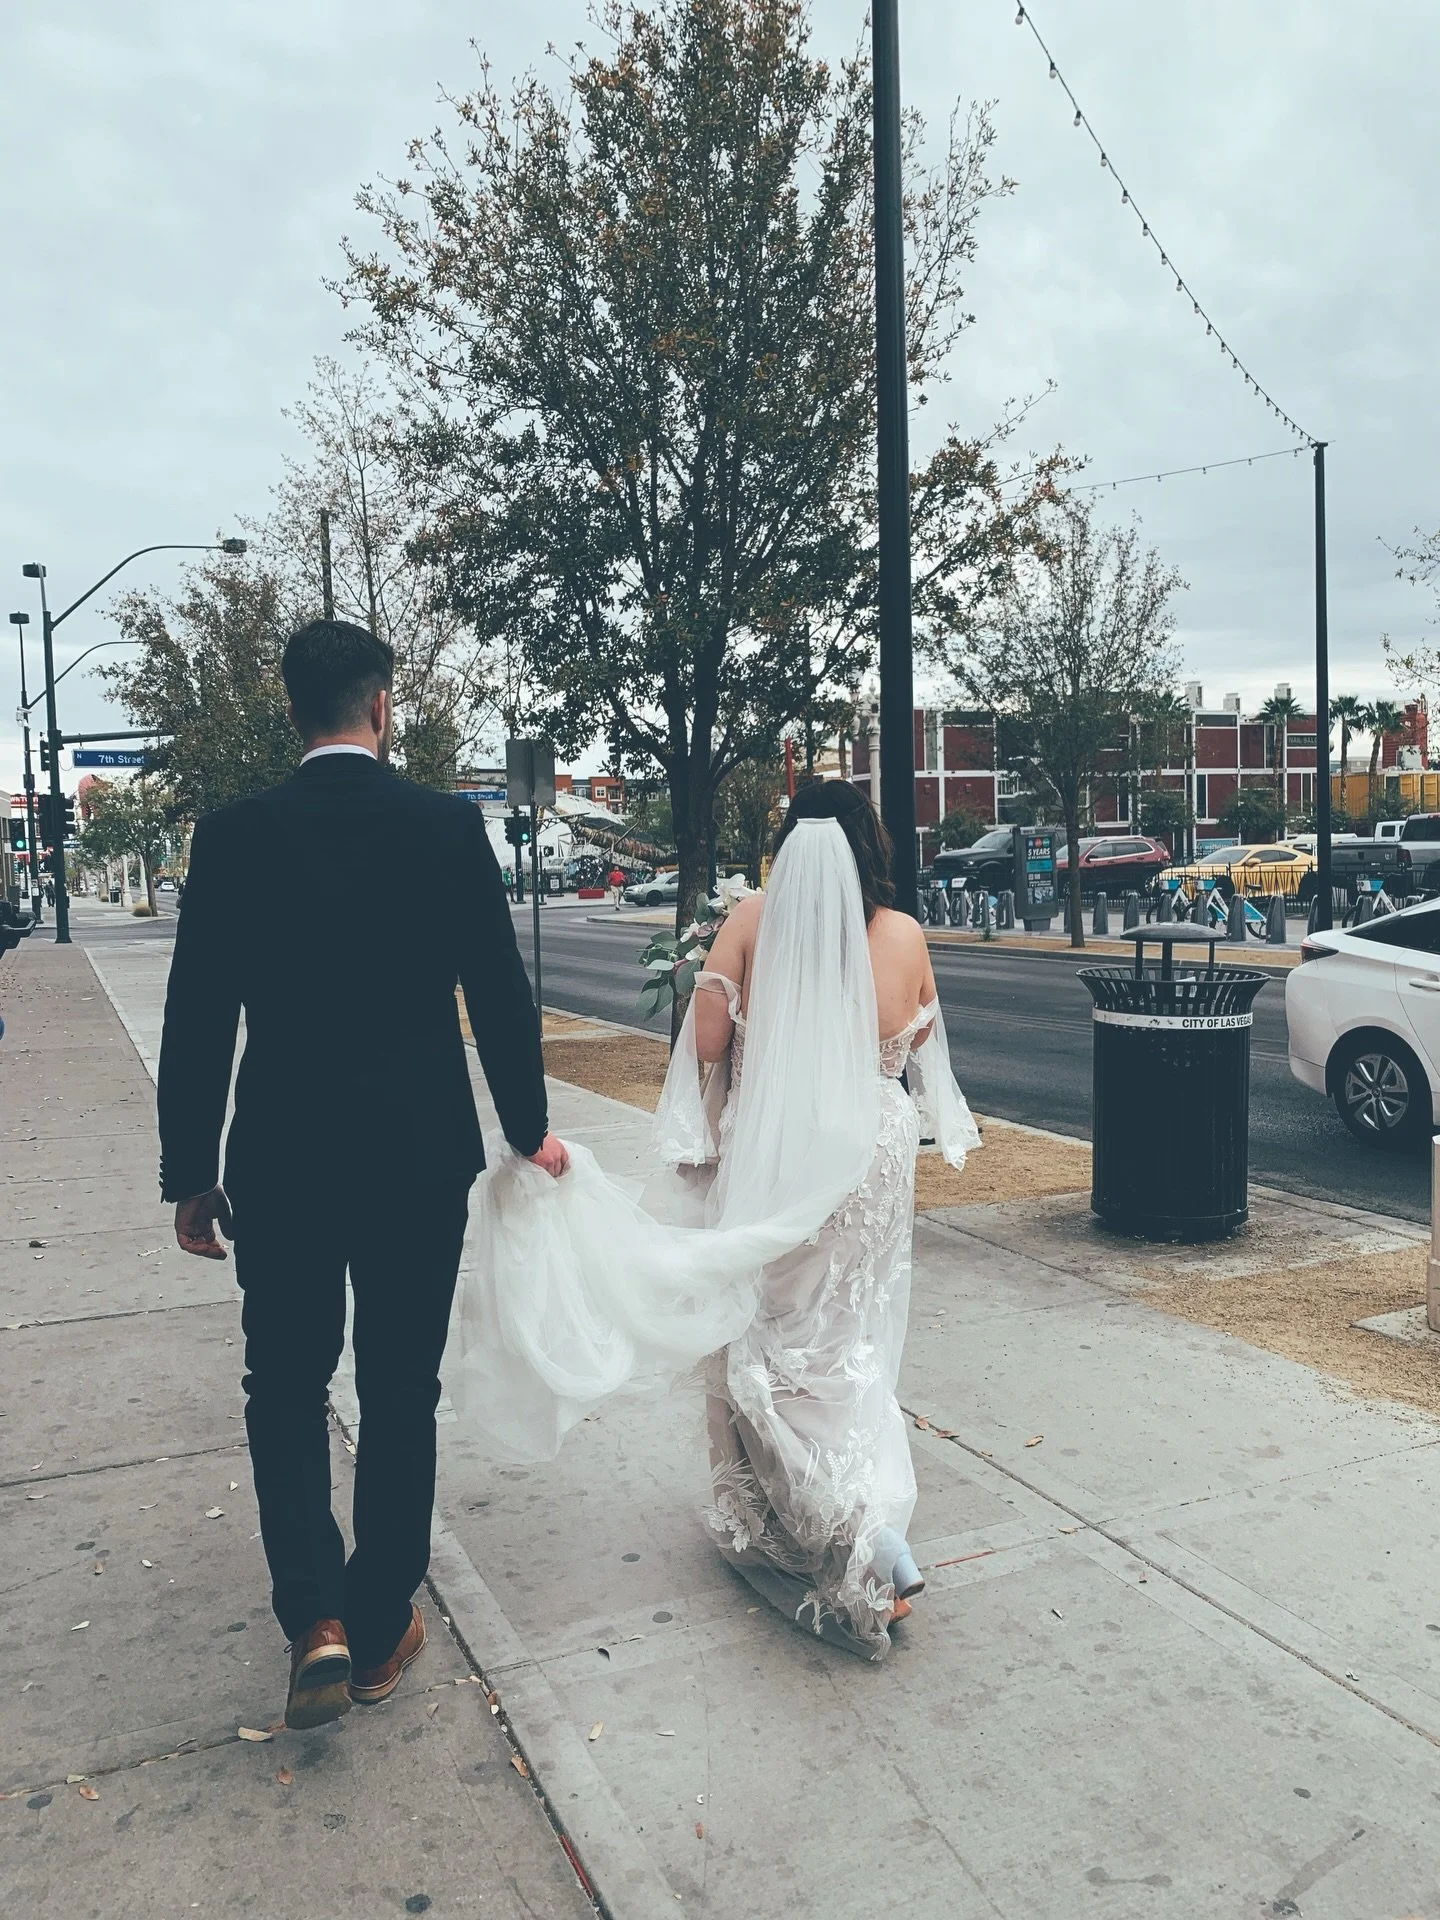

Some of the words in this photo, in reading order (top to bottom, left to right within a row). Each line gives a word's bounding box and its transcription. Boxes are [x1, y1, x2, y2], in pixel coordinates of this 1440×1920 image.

[98, 754, 114, 764] 7th
[1182, 1018, 1205, 1028] CITY
[1206, 1018, 1219, 1028] OF
[1220, 1017, 1236, 1028] LAS
